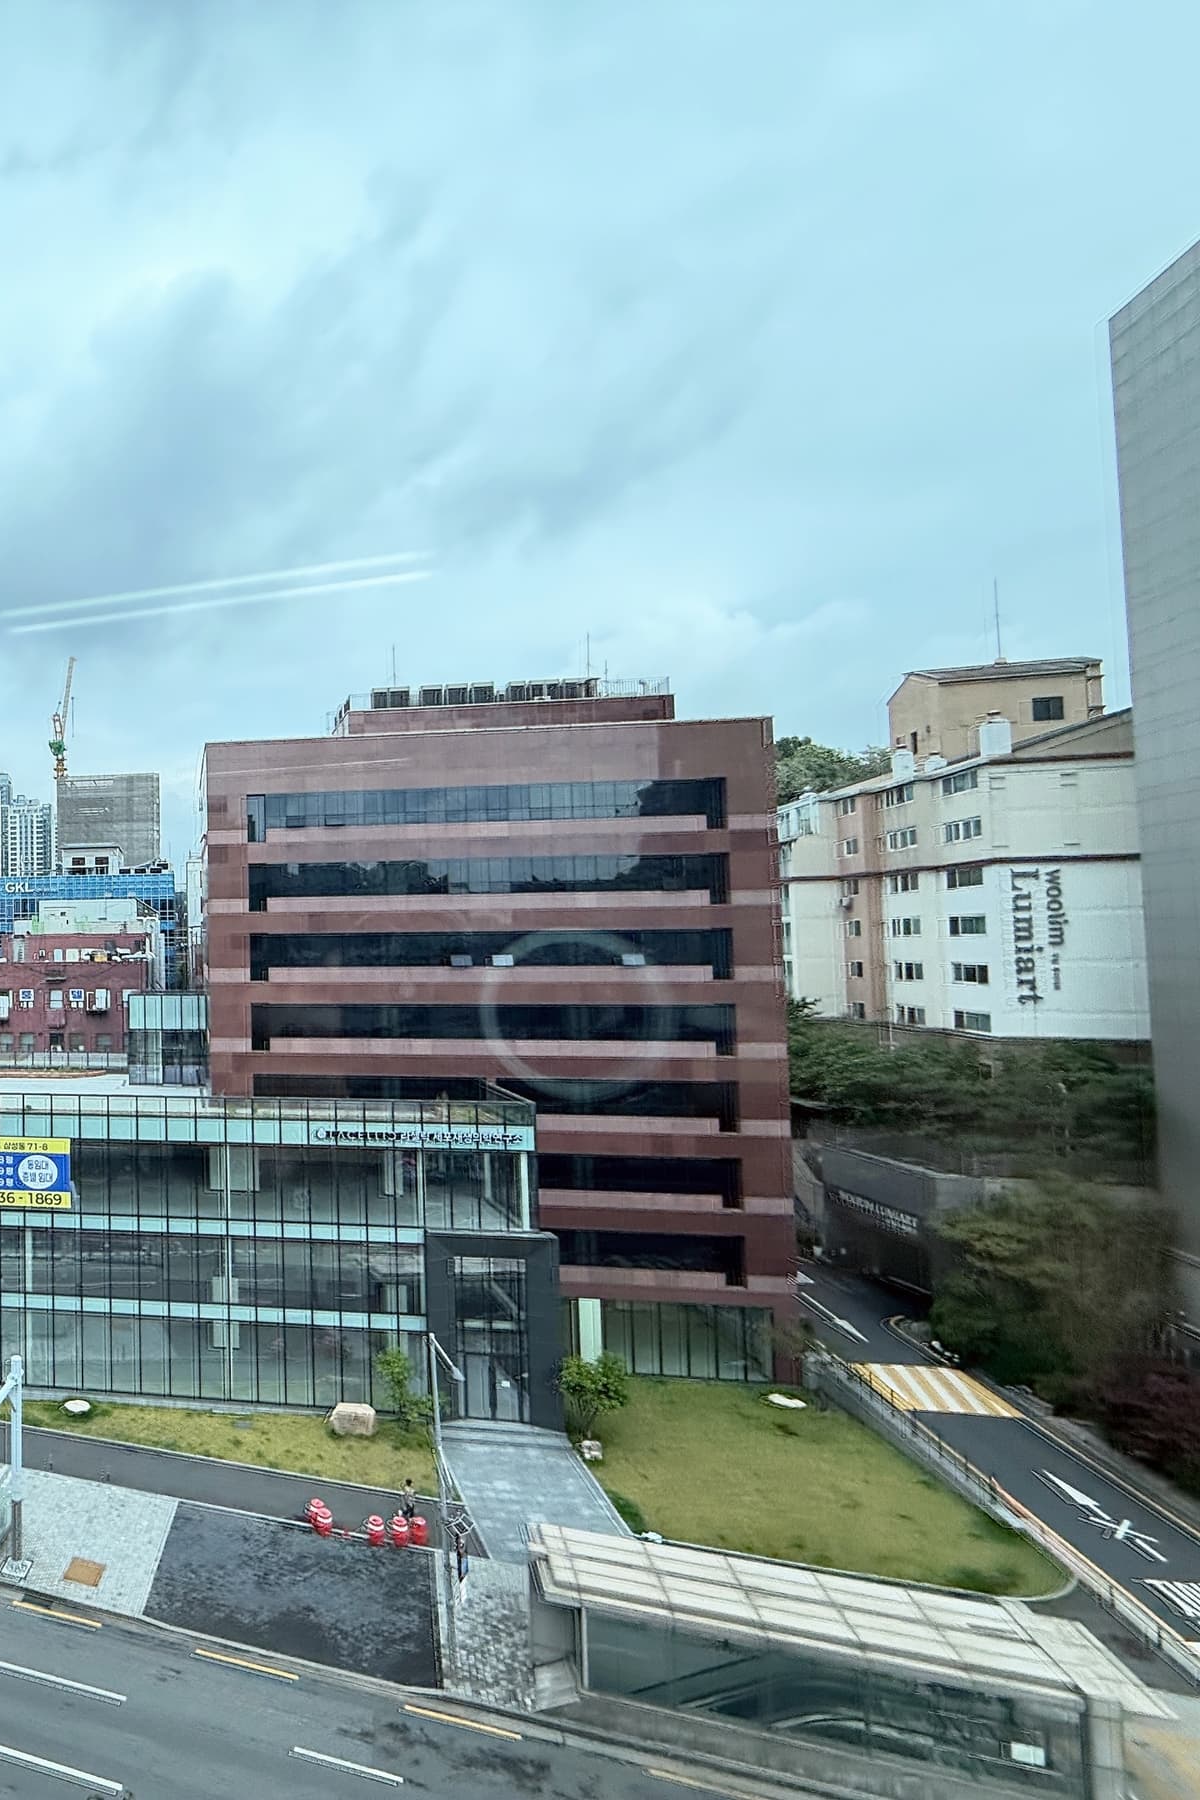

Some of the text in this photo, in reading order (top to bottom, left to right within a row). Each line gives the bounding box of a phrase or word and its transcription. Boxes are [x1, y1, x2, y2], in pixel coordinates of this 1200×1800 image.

[5, 882, 33, 893] GKL
[1010, 868, 1043, 1004] Lumiart
[27, 1143, 49, 1151] 71-8
[28, 1193, 62, 1205] 1869
